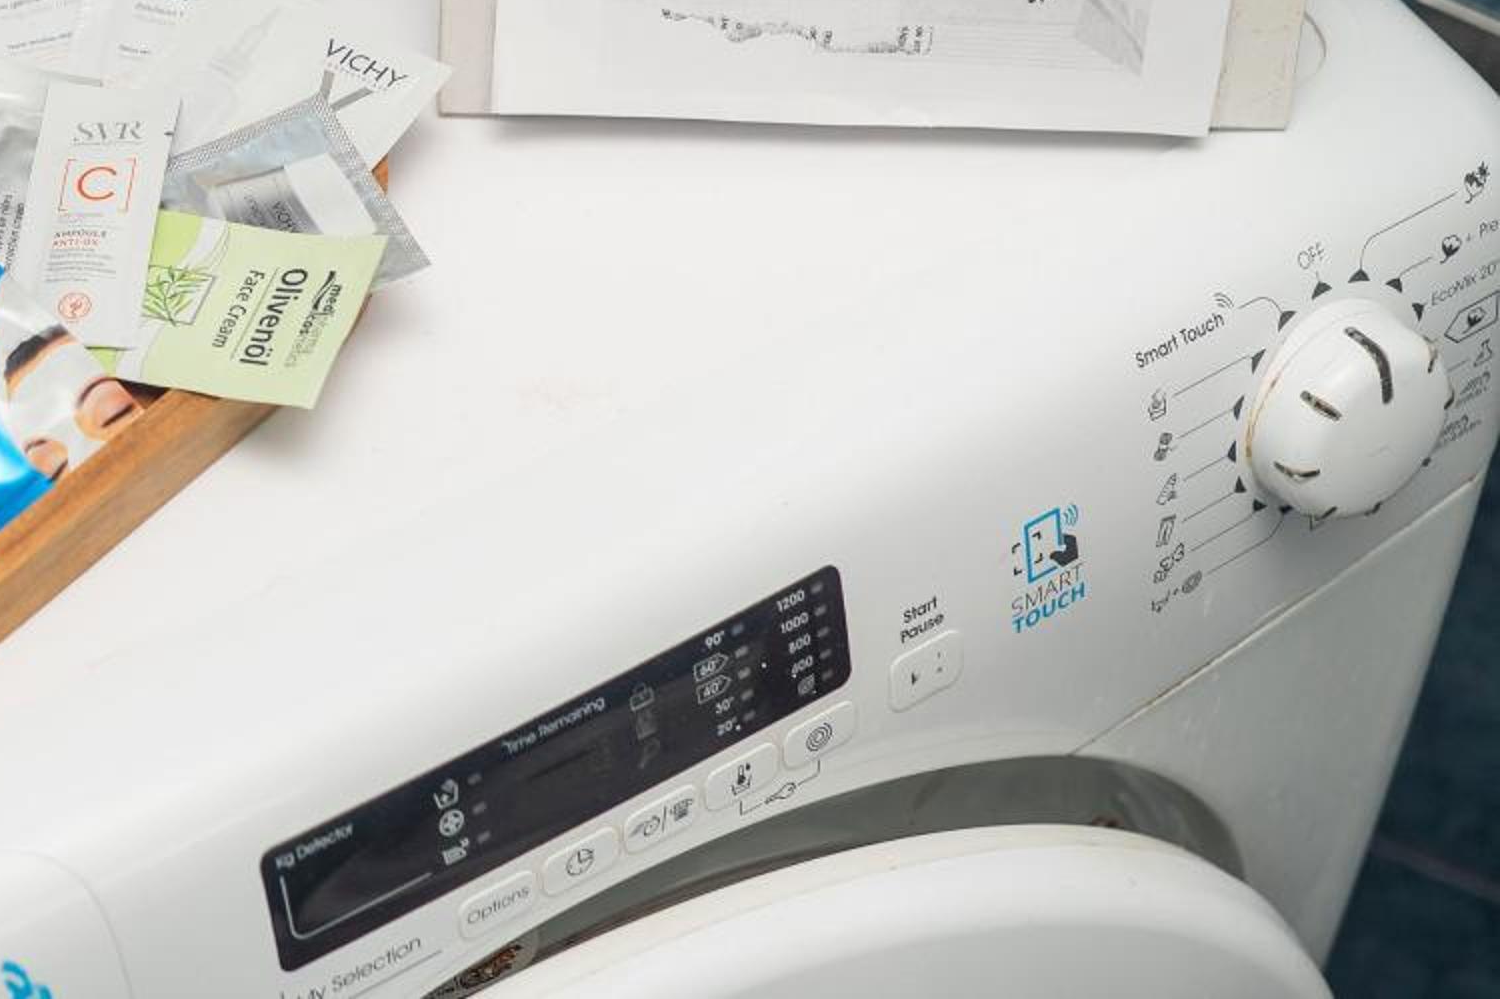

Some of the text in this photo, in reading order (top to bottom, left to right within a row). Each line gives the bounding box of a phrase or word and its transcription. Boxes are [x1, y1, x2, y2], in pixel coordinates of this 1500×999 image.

[325, 38, 408, 88] VICHY
[76, 120, 142, 142] SVR
[237, 269, 267, 304] Face
[212, 306, 248, 349] Cream
[239, 267, 309, 367] Olivenöl
[1134, 311, 1226, 369] Smart Touch
[776, 590, 805, 612] 1200
[1011, 562, 1085, 615] SMART
[1012, 583, 1086, 634] TOUCH
[780, 612, 809, 633] 1000
[900, 613, 945, 644] Pause
[902, 596, 938, 625] Start
[788, 633, 811, 654] 800
[501, 695, 606, 756] Time Remaining
[274, 822, 355, 870] Kg Detector
[465, 883, 531, 925] Options
[330, 935, 423, 993] Selection
